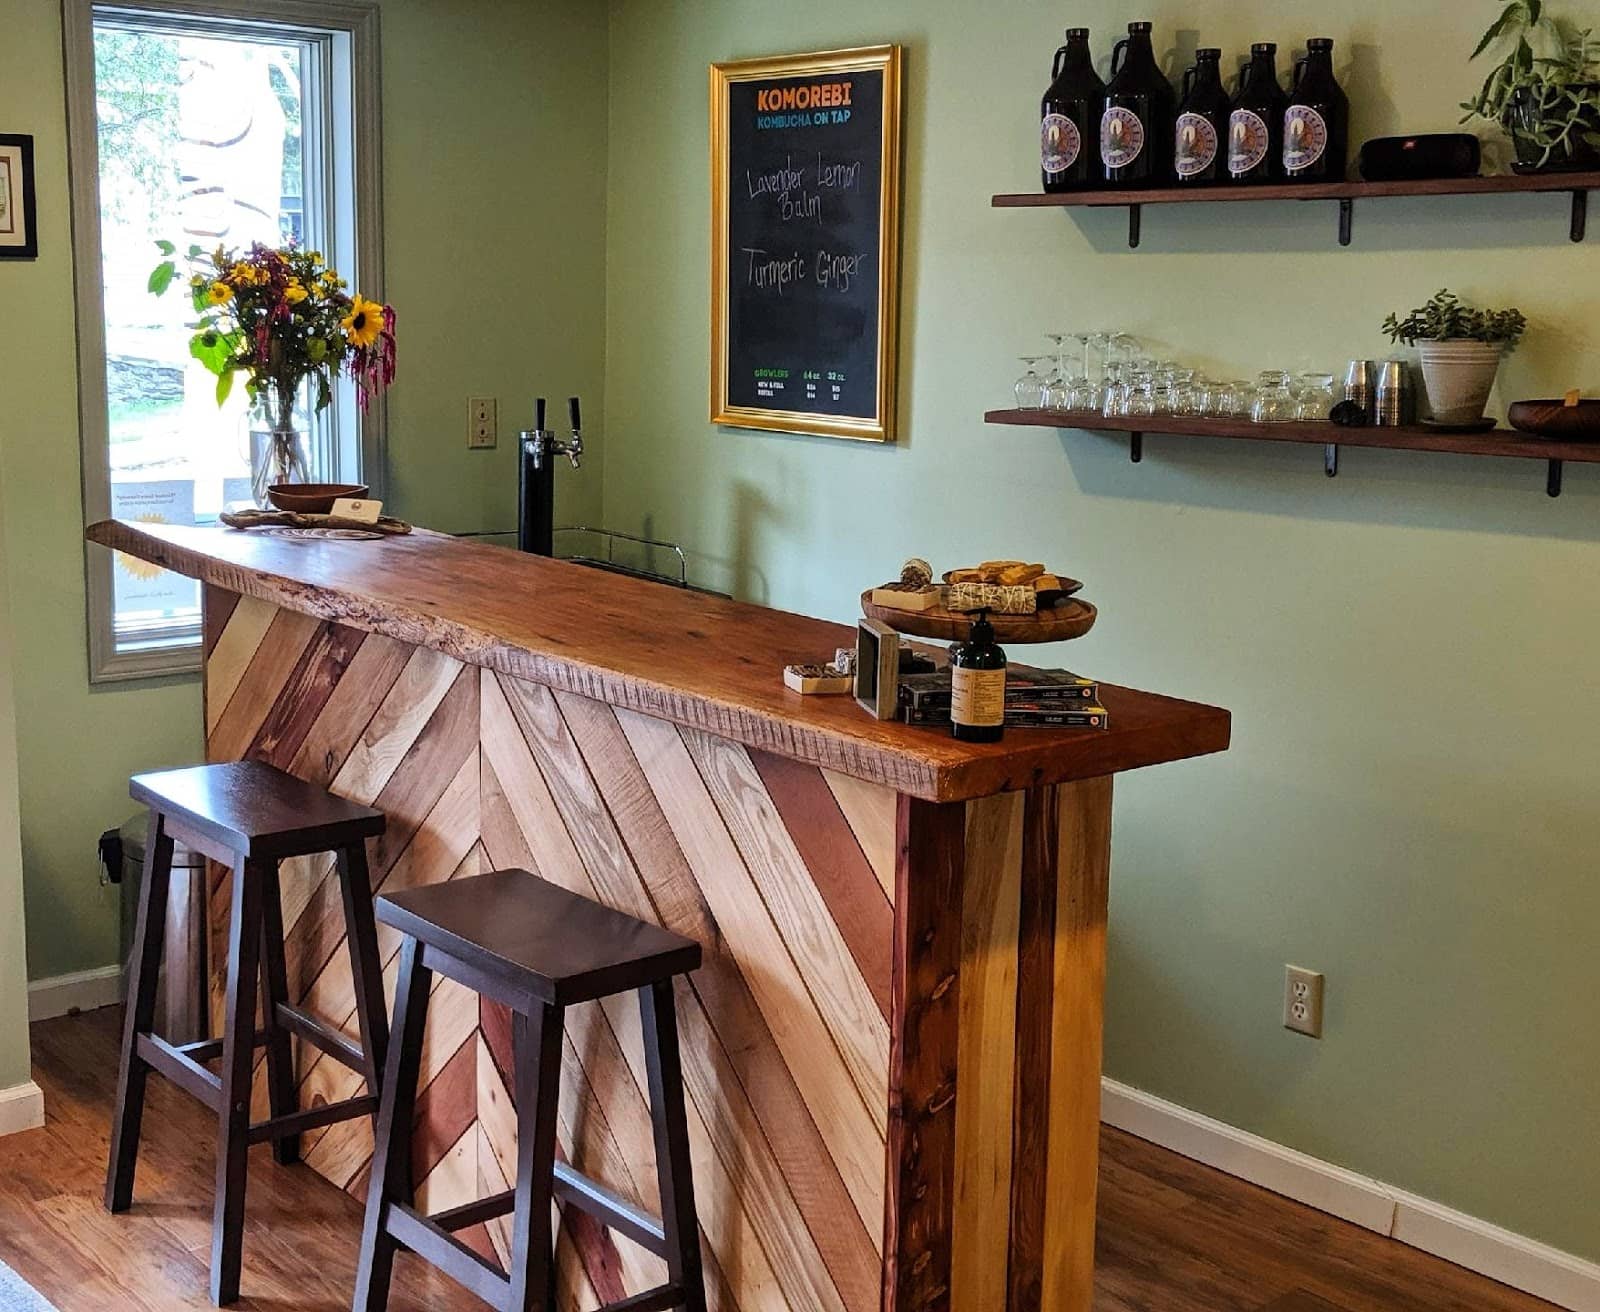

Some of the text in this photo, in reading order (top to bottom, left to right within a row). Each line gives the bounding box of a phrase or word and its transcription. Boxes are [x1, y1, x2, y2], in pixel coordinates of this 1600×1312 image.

[758, 82, 852, 111] KOMOREBI
[757, 109, 851, 129] KOMBUCHA ON TAP
[746, 152, 861, 199] Lavender Lemon
[778, 190, 822, 224] Balm
[741, 247, 868, 296] Turmeric Ginger
[754, 369, 789, 379] GROWLERS
